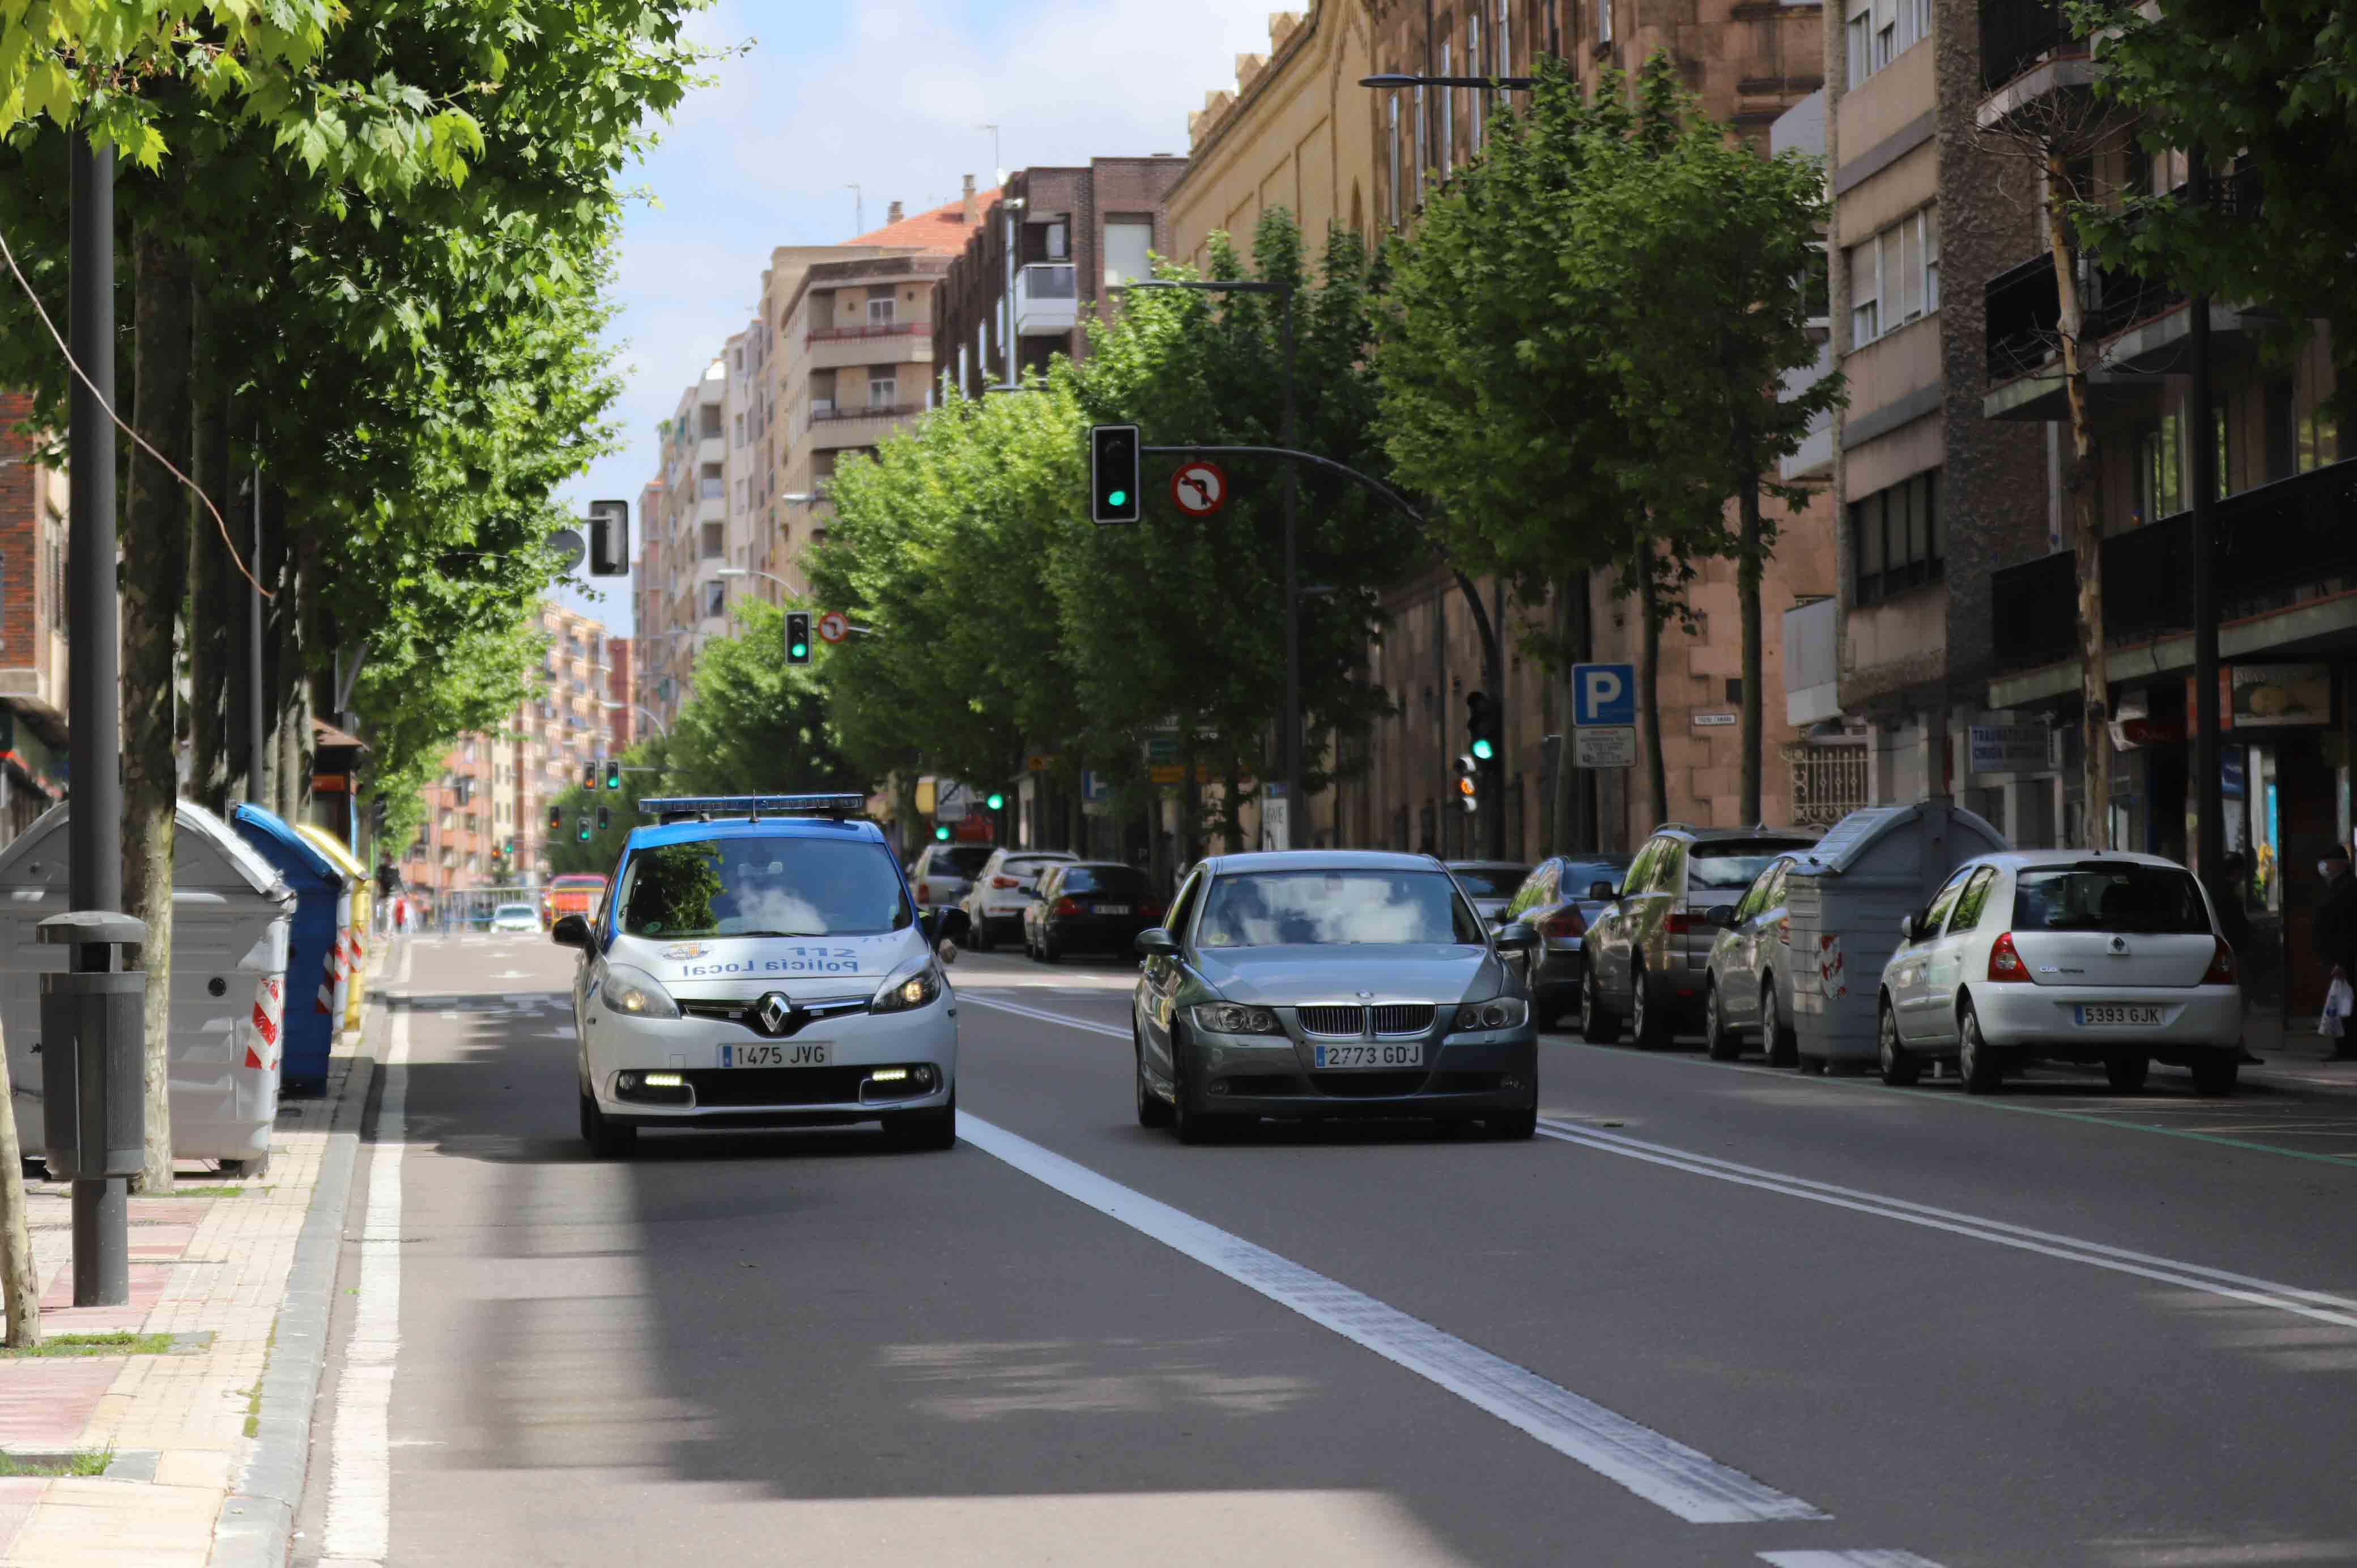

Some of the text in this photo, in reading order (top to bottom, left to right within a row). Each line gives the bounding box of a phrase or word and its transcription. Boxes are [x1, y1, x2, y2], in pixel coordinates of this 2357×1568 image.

[1586, 672, 1622, 718] P
[2085, 1008, 2158, 1022] 5393 GJK
[737, 1046, 824, 1065] 1475 JVG
[1329, 1047, 1419, 1064] 2773 GDJ
